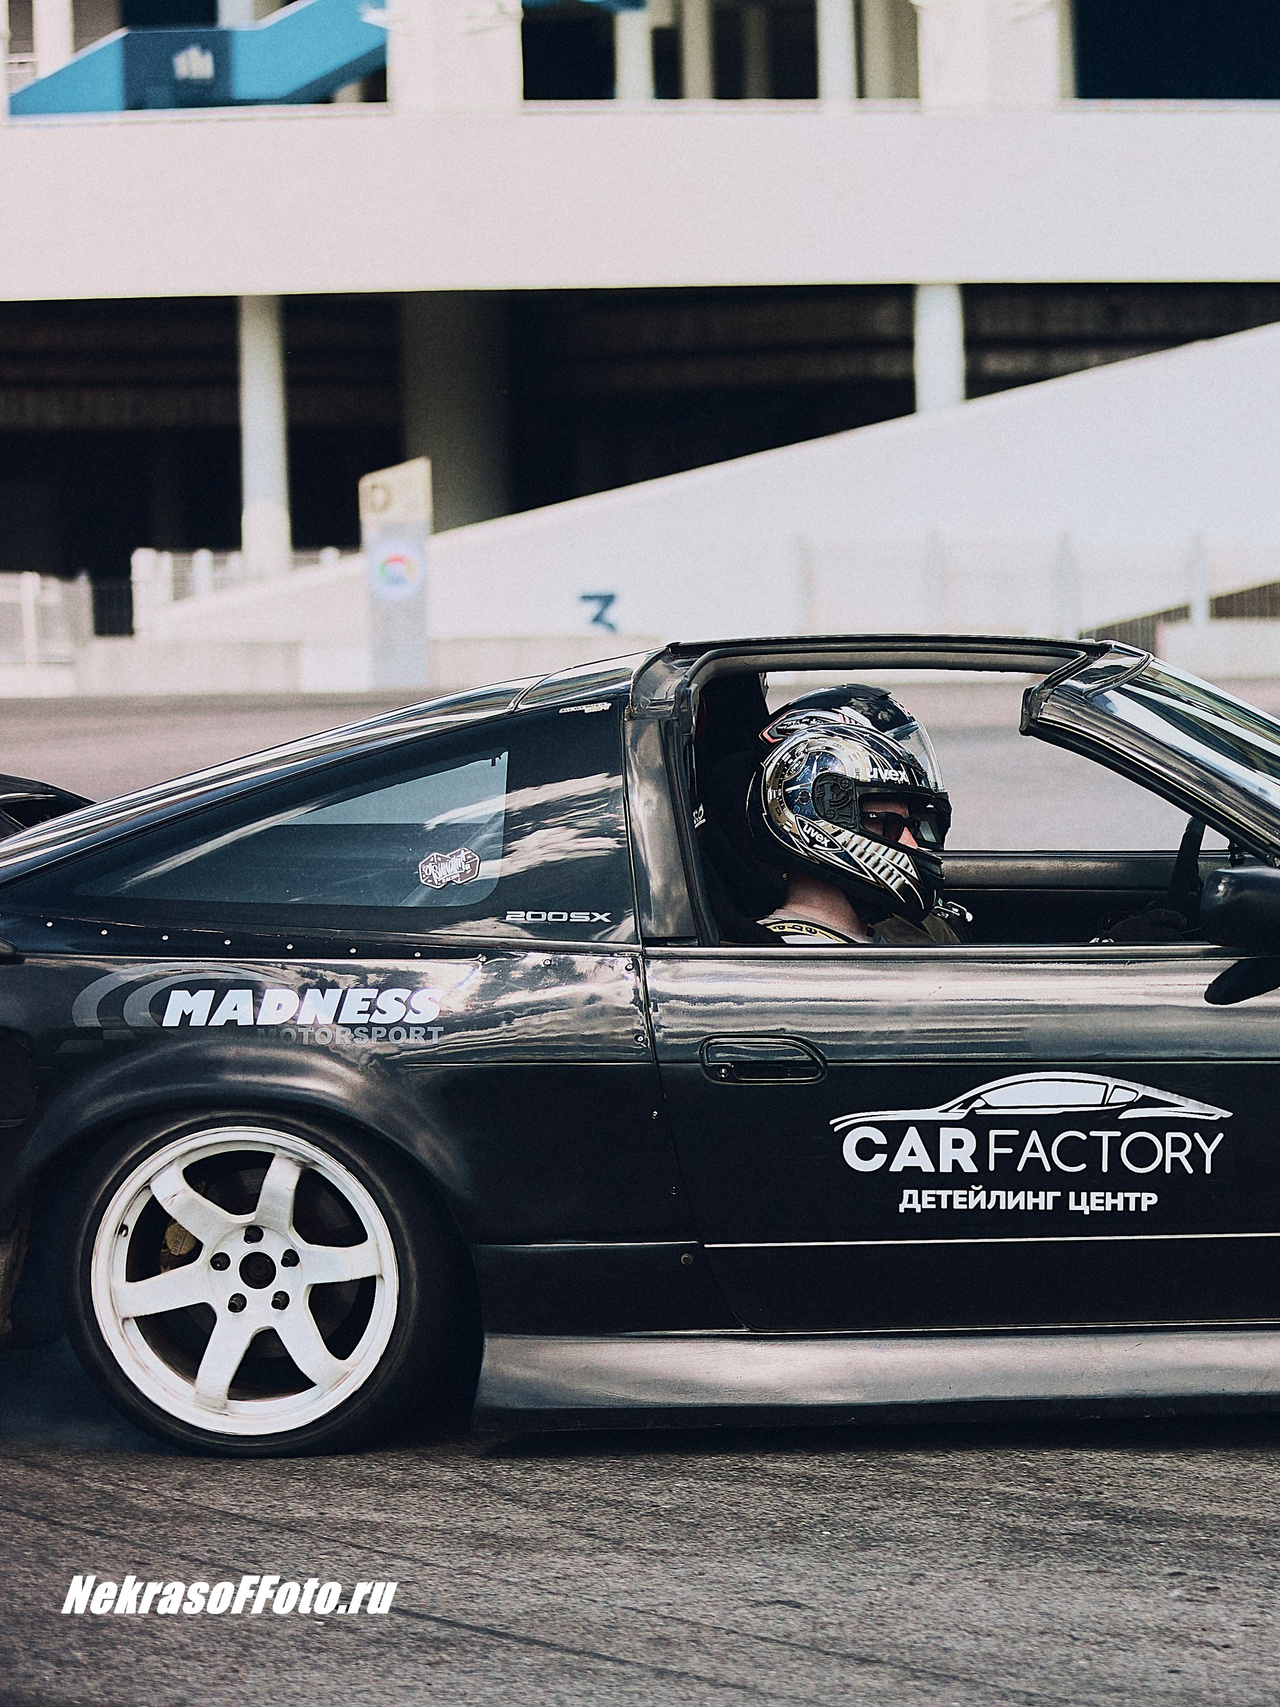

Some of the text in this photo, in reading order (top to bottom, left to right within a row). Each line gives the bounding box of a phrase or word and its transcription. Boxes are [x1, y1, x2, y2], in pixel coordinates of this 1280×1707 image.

[866, 767, 910, 785] uvex
[803, 822, 831, 847] uvex
[505, 910, 612, 923] 200SX
[162, 988, 446, 1027] MADNESS
[257, 1026, 444, 1046] MOTORSPORT
[842, 1126, 1224, 1174] CAR FACTORY
[898, 1185, 1159, 1215] ДЕТЕЙЛИНГ ЦЕНТР
